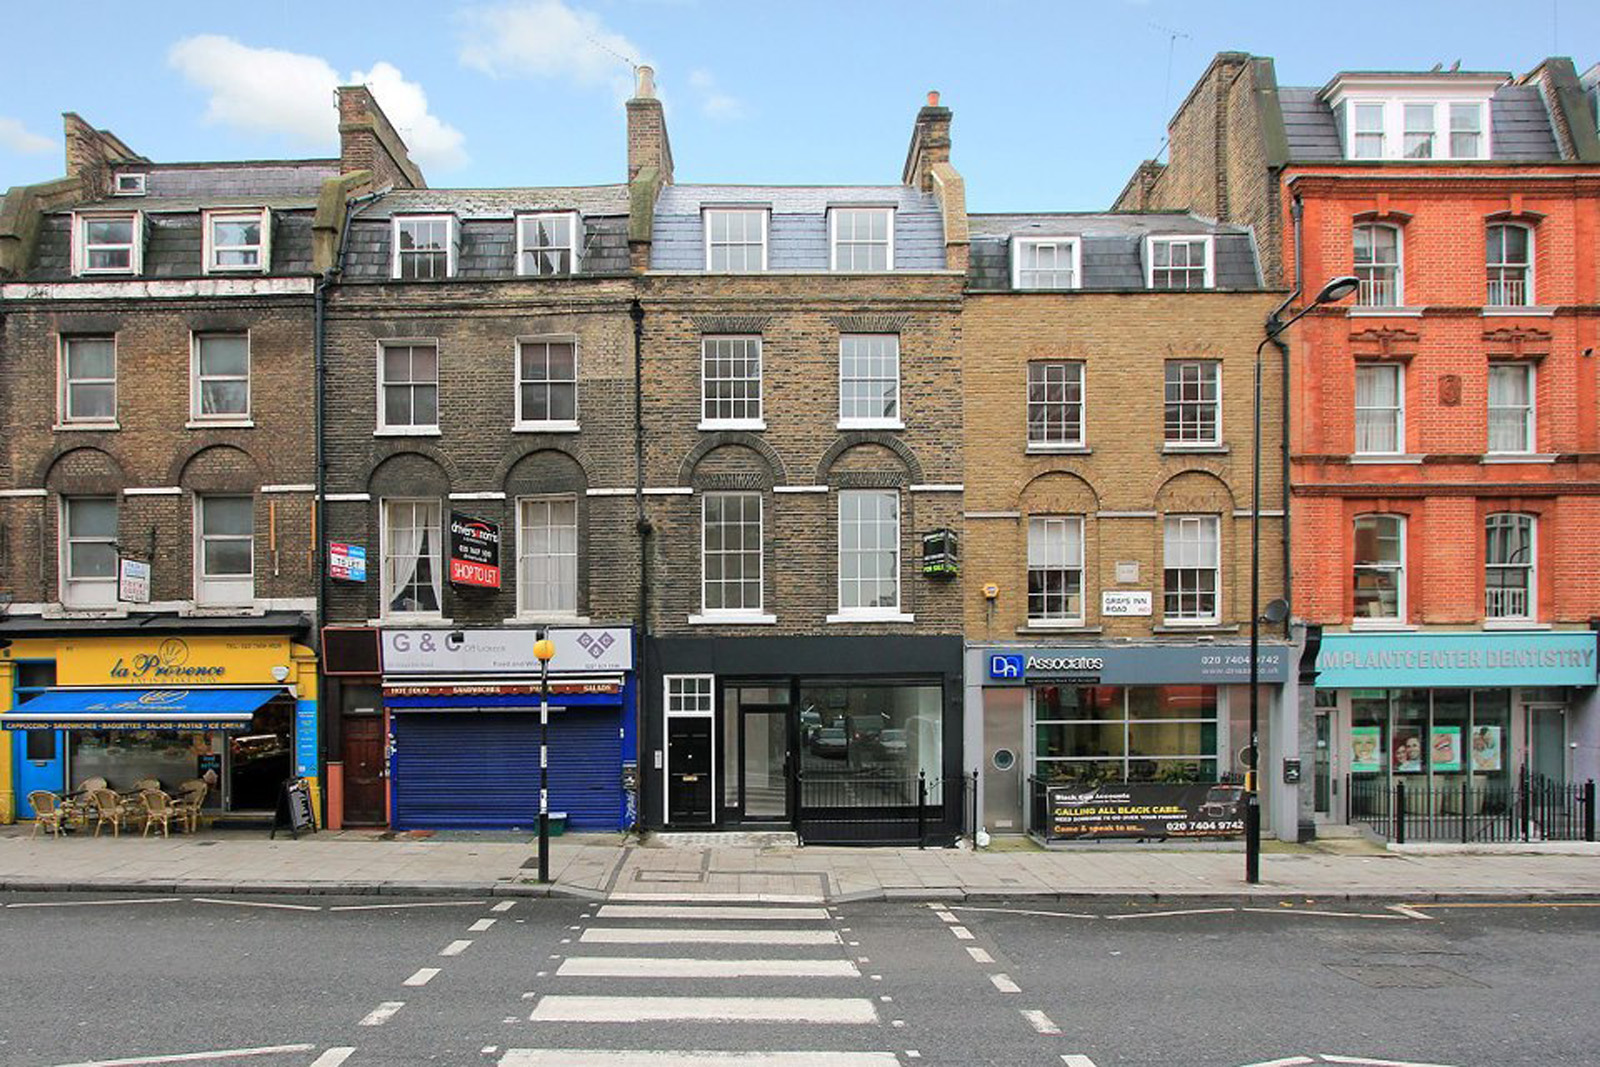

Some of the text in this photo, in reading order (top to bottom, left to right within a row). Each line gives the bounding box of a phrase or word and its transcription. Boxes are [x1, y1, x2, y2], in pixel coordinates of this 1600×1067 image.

[336, 558, 361, 568] TO LET
[454, 563, 497, 584] SHOP TO LET
[393, 633, 411, 652] G
[419, 633, 437, 652] &
[1026, 656, 1103, 670] Associates
[1201, 655, 1279, 664] 020 7404 742
[1487, 648, 1594, 668] DENTISTRY
[110, 653, 225, 678] la Provence
[1055, 808, 1096, 816] CALLING
[1098, 807, 1116, 815] ALL
[1089, 824, 1115, 833] speak
[1166, 820, 1244, 831] 020 7404 9742
